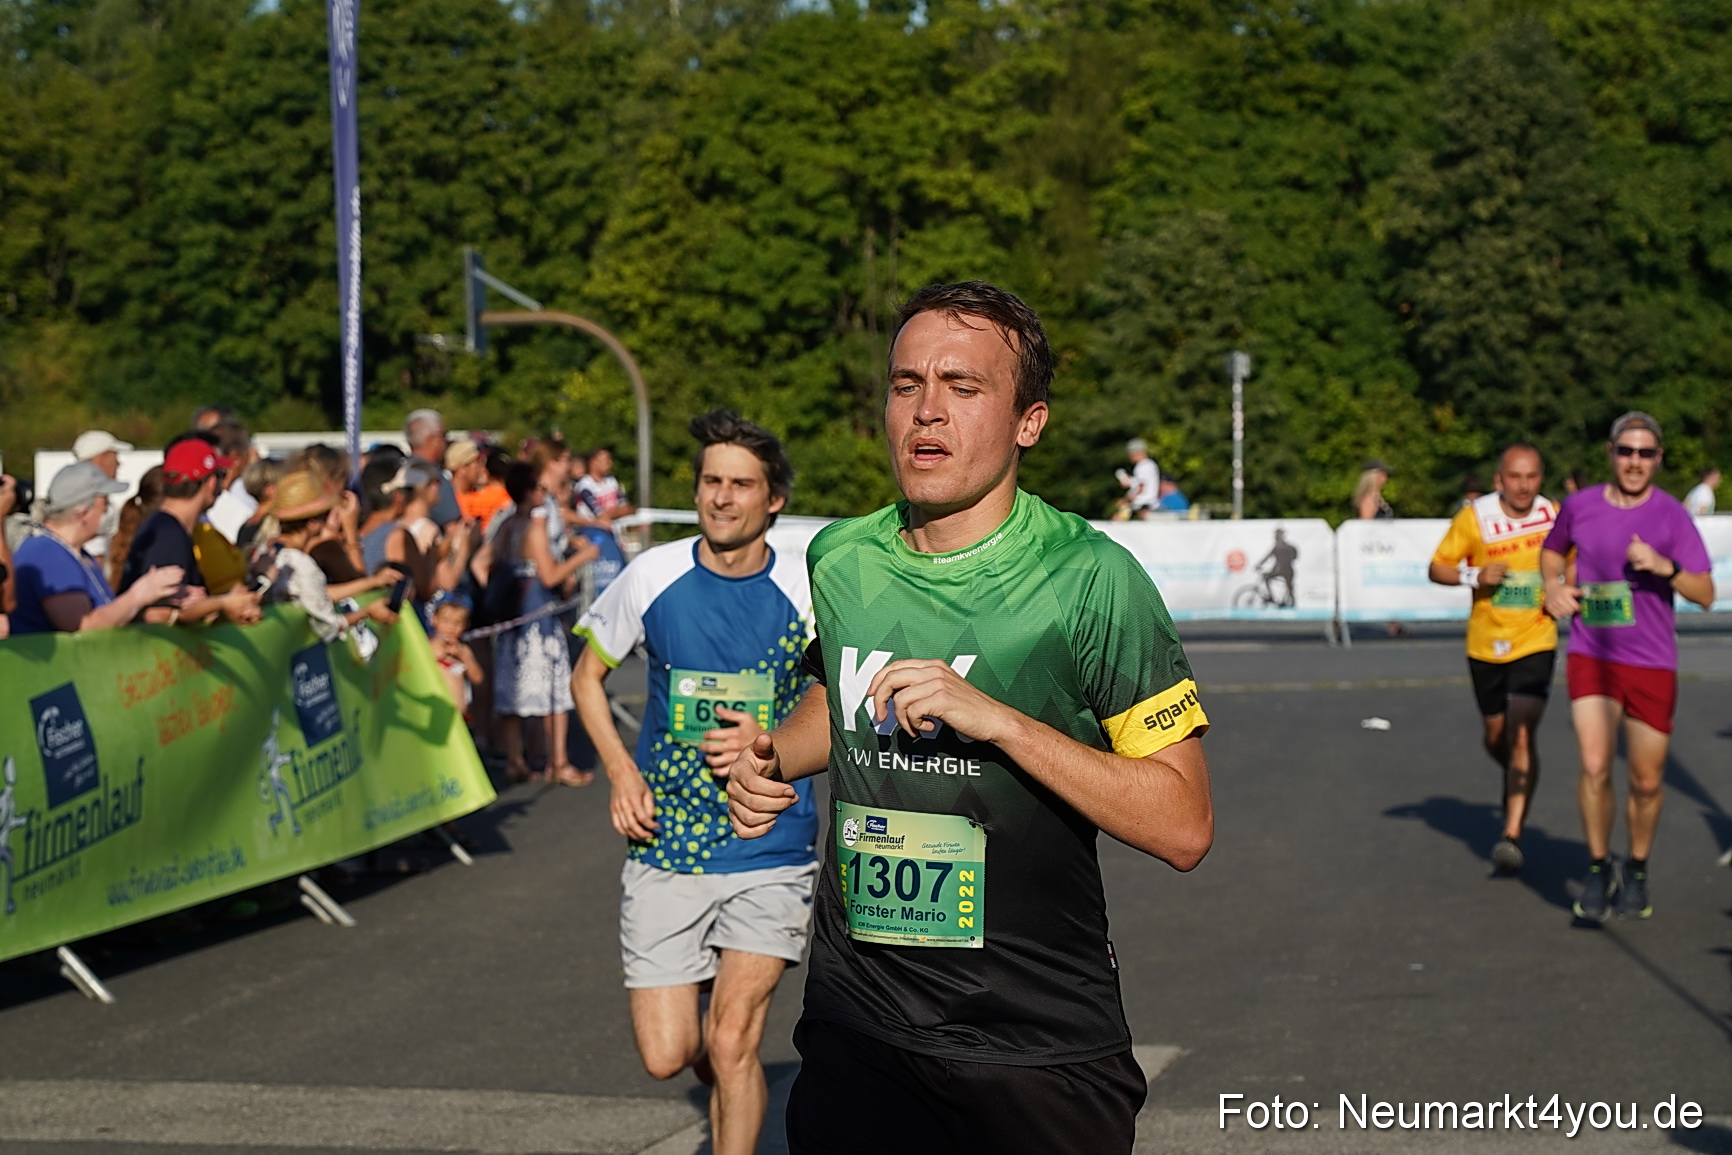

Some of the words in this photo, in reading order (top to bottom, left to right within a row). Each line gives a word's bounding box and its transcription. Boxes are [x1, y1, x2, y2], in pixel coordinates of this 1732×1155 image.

[933, 532, 1003, 564] #teamkwenergie
[878, 751, 981, 776] ENERGIE
[859, 833, 905, 845] Firmenlauf
[849, 853, 953, 903] 1307
[850, 899, 896, 919] Forster
[901, 906, 947, 922] Mario
[958, 870, 975, 928] 2022
